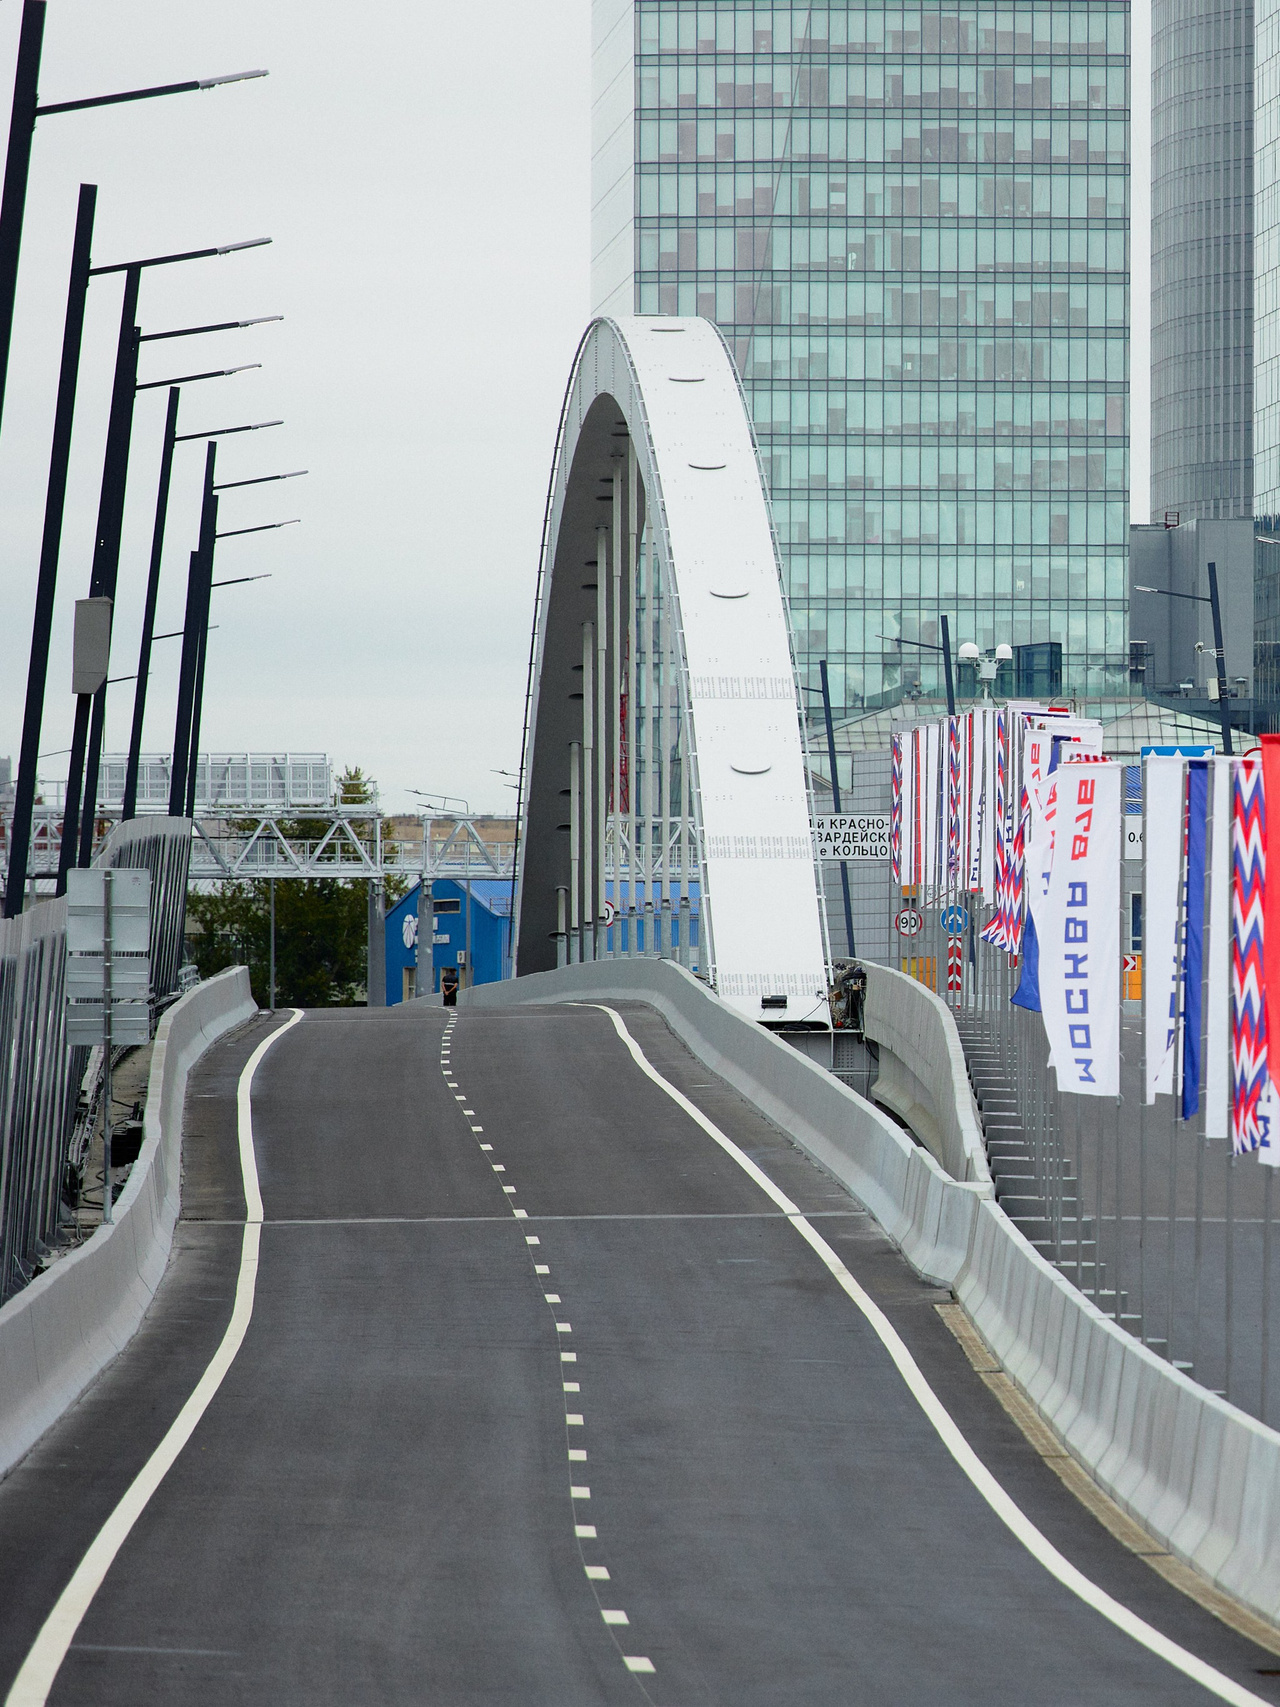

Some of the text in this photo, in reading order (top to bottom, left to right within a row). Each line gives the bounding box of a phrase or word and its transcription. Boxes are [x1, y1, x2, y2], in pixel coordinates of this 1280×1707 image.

[830, 818, 889, 830] КРАСНО-
[810, 829, 891, 844] ВАРДЕЙСК
[832, 845, 888, 858] КОЛЬЦО
[901, 917, 917, 928] 90
